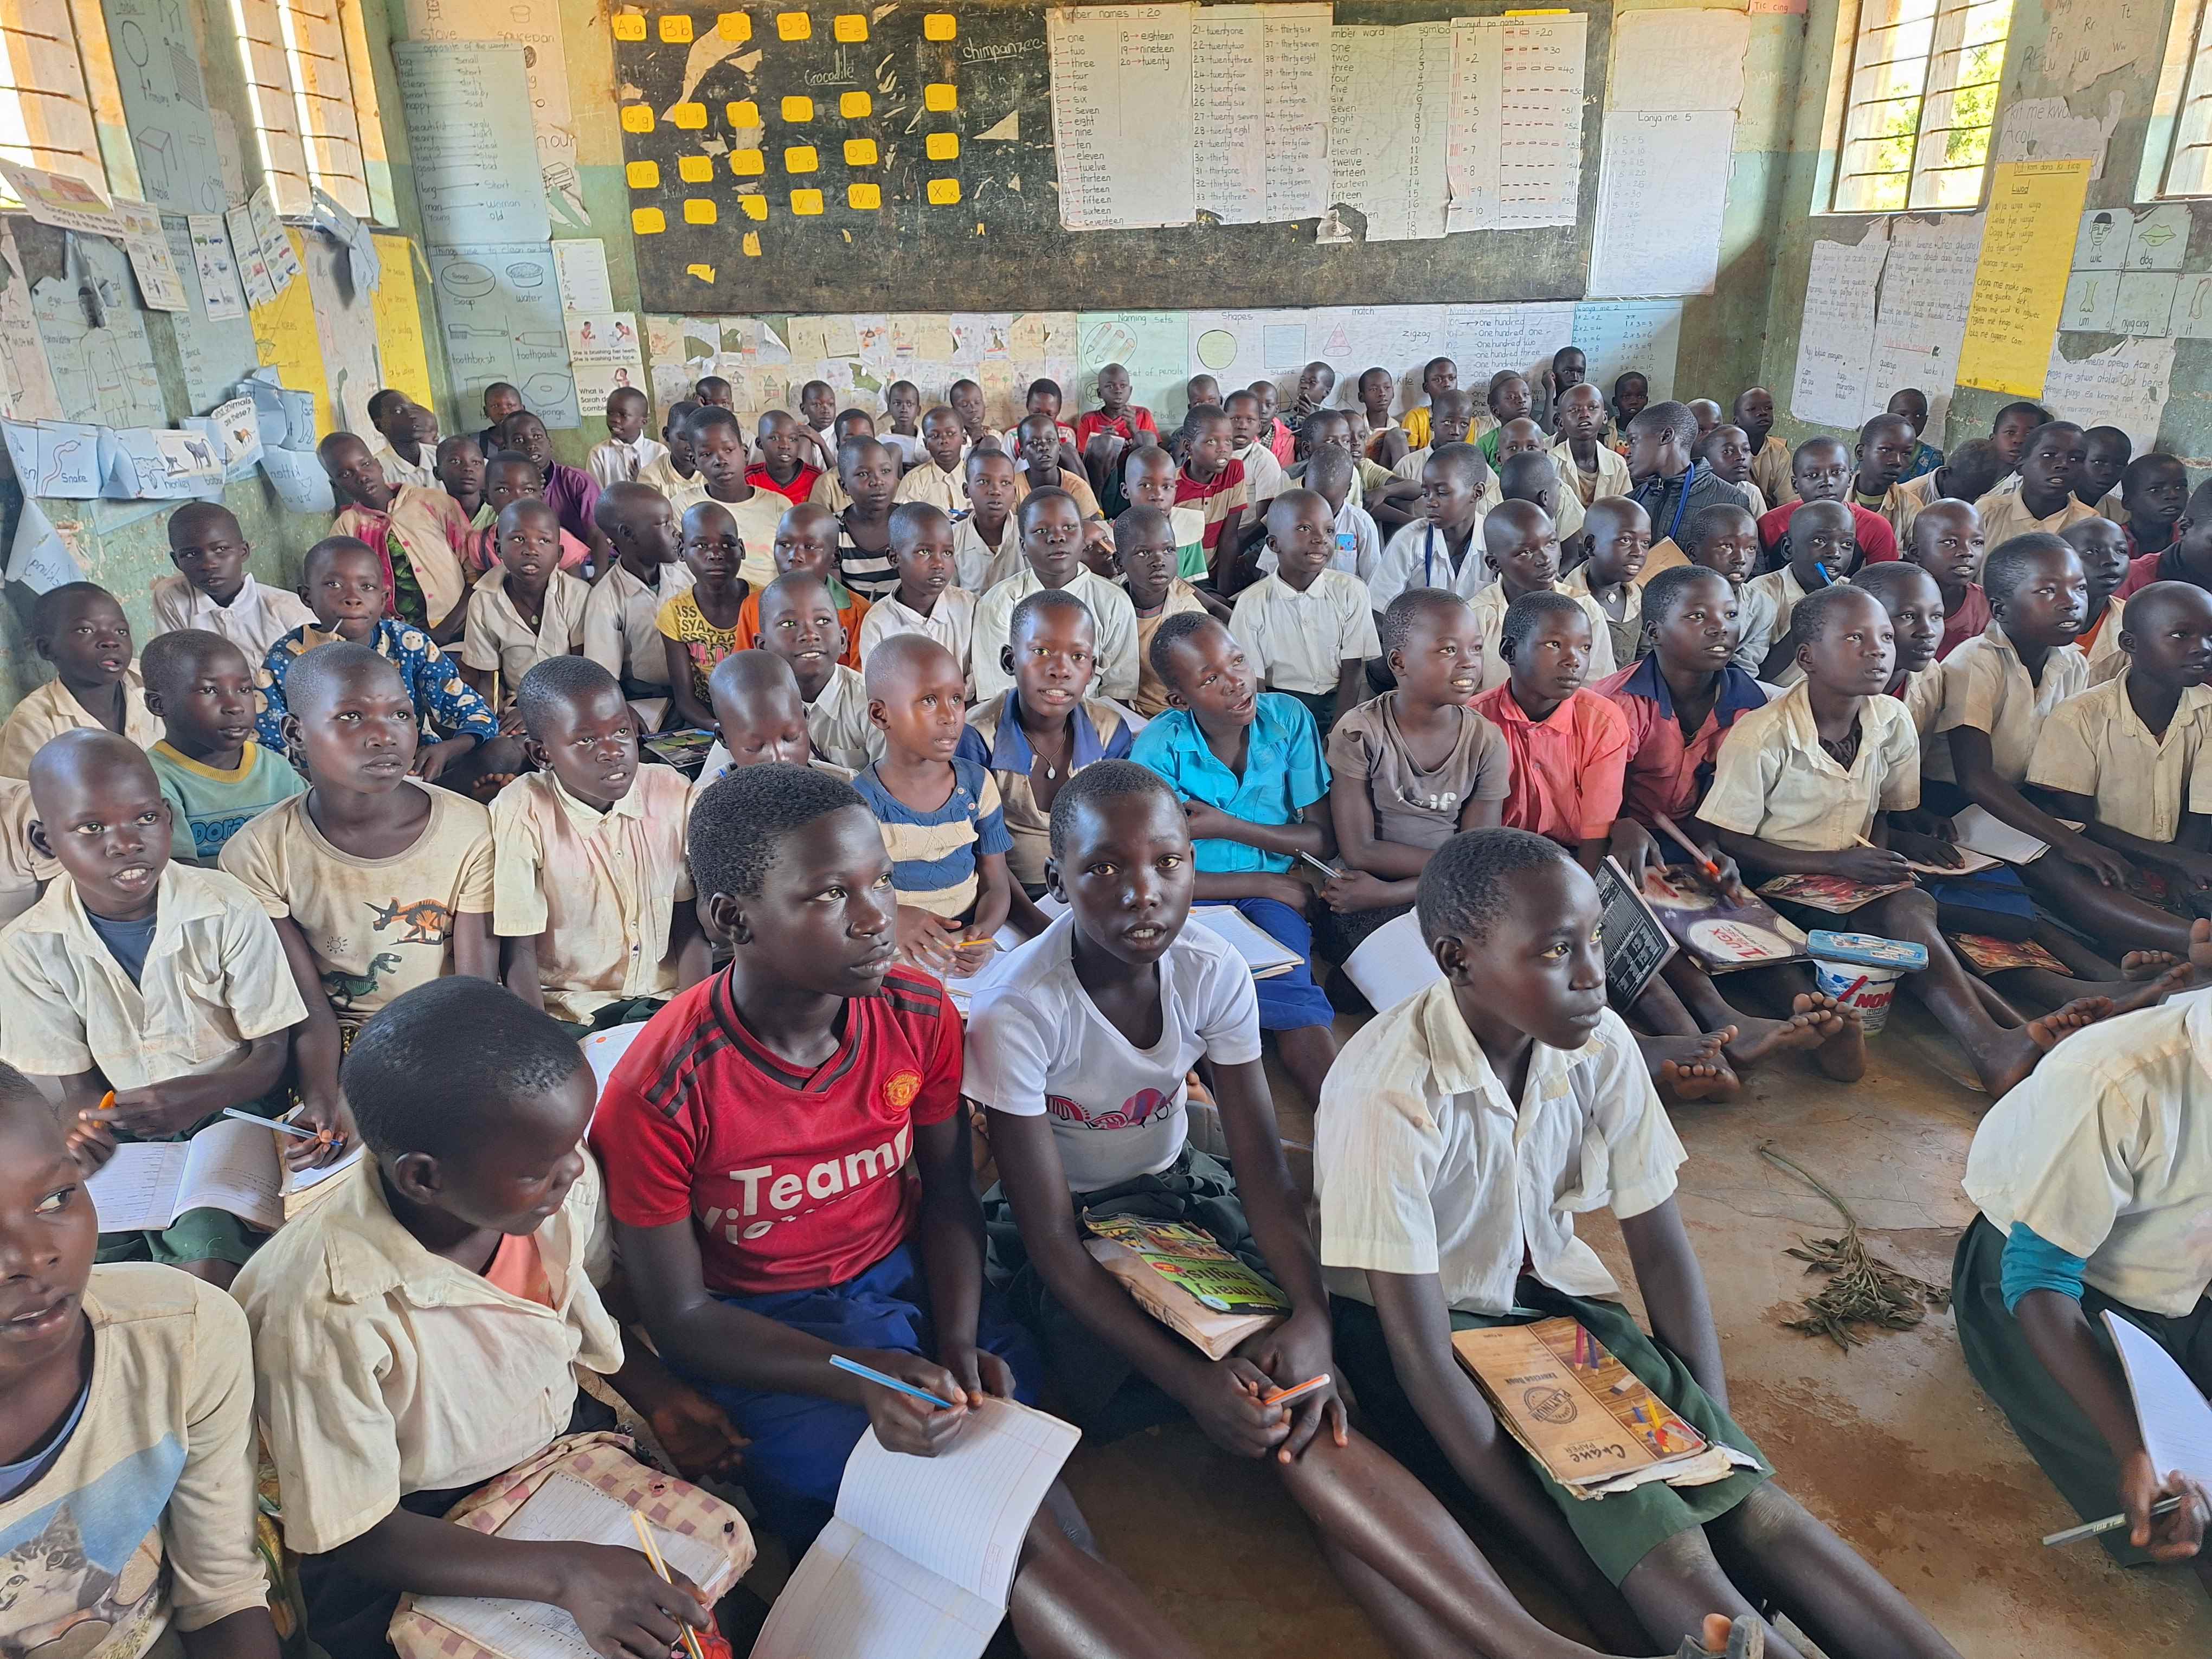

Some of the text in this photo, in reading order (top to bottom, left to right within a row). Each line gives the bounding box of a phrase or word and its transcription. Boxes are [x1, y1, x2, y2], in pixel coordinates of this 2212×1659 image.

[1754, 2, 1788, 13] Tic cing
[1121, 29, 1174, 42] 18 eighteen
[1363, 27, 1385, 37] word
[1418, 25, 1450, 36] symbo
[1070, 47, 1085, 55] two
[1121, 43, 1174, 55] 19 nineteen
[1419, 50, 1424, 60] 2
[1071, 57, 1095, 67] three
[1141, 55, 1169, 70] twenty
[1418, 62, 1424, 70] 3
[1332, 64, 1354, 72] three
[1072, 70, 1089, 80] four
[1332, 74, 1349, 83] four
[1073, 82, 1089, 91] five
[1331, 85, 1348, 93] five
[1417, 82, 1423, 91] 5
[1417, 93, 1423, 102] 6
[1331, 105, 1356, 113] seven
[2028, 104, 2043, 119] me
[1075, 117, 1094, 127] eight
[1332, 114, 1354, 125] eight
[1414, 113, 1420, 123] 8
[1638, 112, 1662, 127] Lanya
[1414, 124, 1420, 132] 9
[1331, 147, 1361, 156] eleven
[1332, 158, 1362, 166] twelve
[1410, 156, 1419, 164] 12
[1410, 166, 1419, 176] 13
[1080, 173, 1111, 183] thirteen
[1409, 179, 1419, 187] 14
[1332, 179, 1368, 189] fourteen
[1331, 191, 1362, 201] fifteen
[1409, 190, 1419, 198] 15
[1083, 197, 1111, 205] fifteen
[1409, 200, 1419, 208] 16
[1408, 211, 1417, 219] 17
[1407, 221, 1417, 232] 18
[2090, 254, 2102, 263] wic
[516, 291, 542, 302] water
[1352, 307, 1375, 317] match
[1118, 313, 1173, 325] Naming sets
[1221, 312, 1254, 324] Shapes
[1495, 313, 1525, 326] hundred
[2079, 317, 2089, 326] um
[1495, 324, 1523, 336] hundred
[2185, 323, 2192, 335] it
[1402, 330, 1431, 343] zigzag
[1492, 337, 1520, 347] hundred
[1491, 346, 1540, 358] hundred three
[1492, 356, 1520, 367] hundred
[1146, 368, 1154, 376] of
[1159, 364, 1183, 376] pencils
[1396, 373, 1414, 386] kite
[1530, 1389, 1572, 1422] PLATINUM
[1565, 1442, 1596, 1454] PAPER
